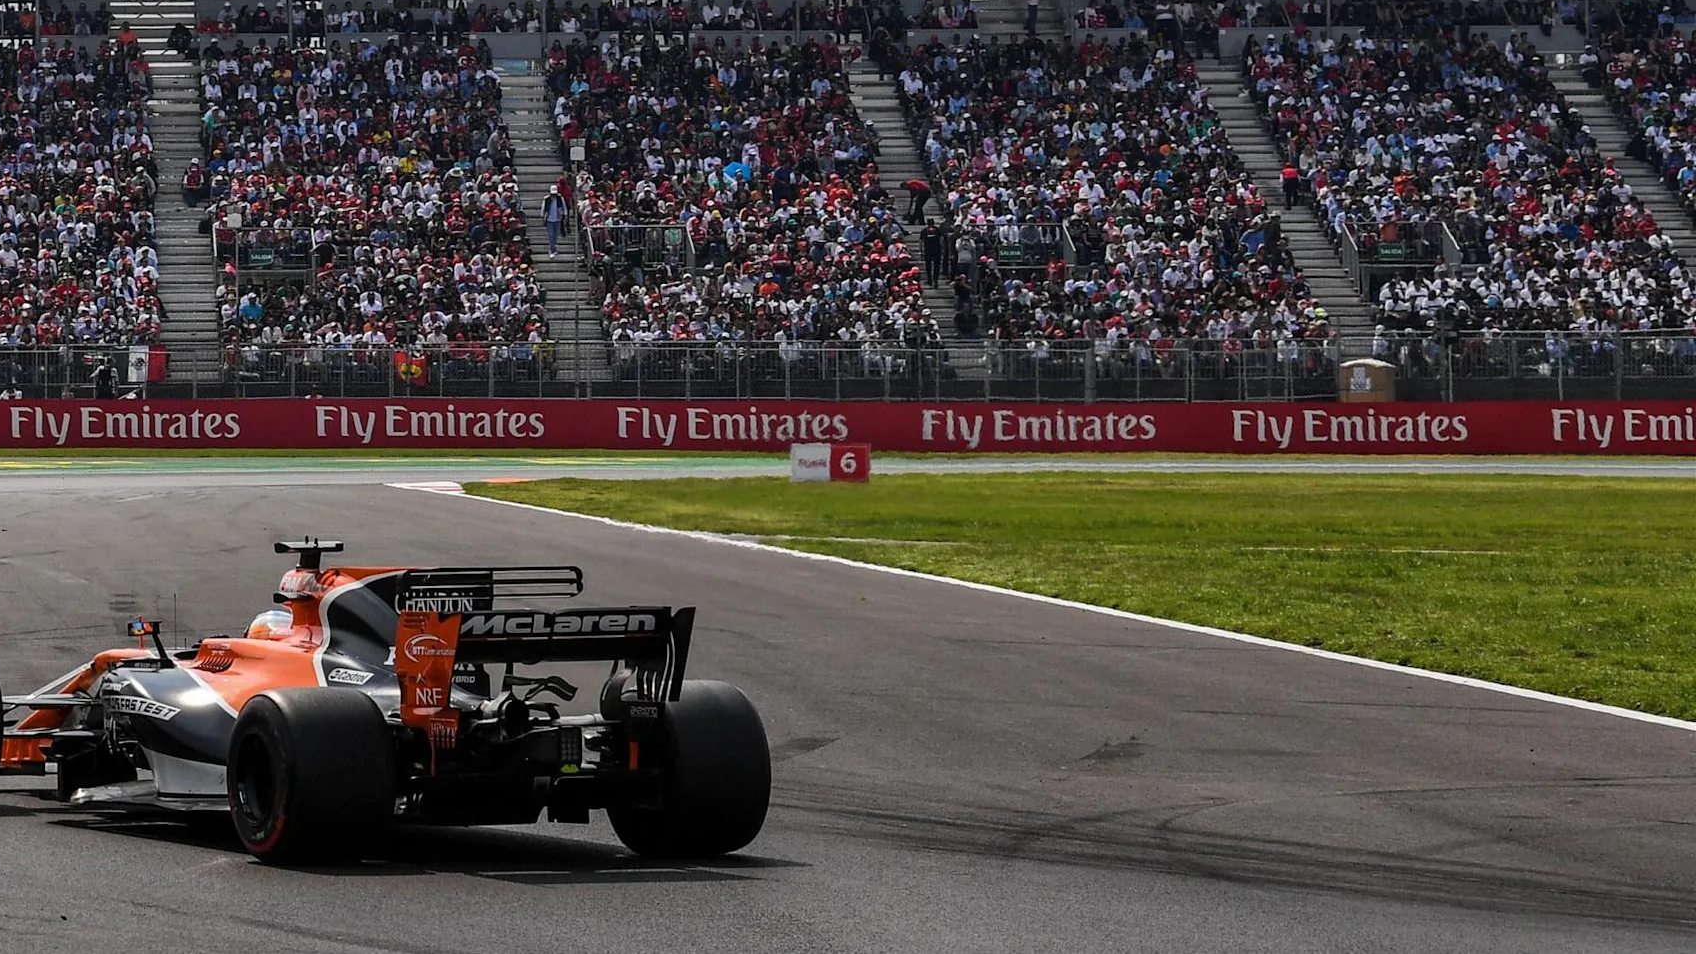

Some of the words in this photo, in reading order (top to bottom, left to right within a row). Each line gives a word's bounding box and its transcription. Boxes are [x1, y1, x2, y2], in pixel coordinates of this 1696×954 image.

[9, 406, 71, 446] Fly
[79, 406, 241, 439] Emirates
[314, 405, 376, 444] Fly
[384, 405, 545, 438] Emirates
[616, 406, 678, 447] Fly
[686, 406, 849, 442] Emirates
[922, 409, 984, 449] Fly
[992, 408, 1157, 442] Emirates
[1231, 409, 1293, 449] Fly
[1302, 408, 1468, 442] Emirates
[1551, 408, 1614, 449] Fly
[840, 452, 857, 474] 6
[459, 613, 656, 635] McLaren
[337, 670, 370, 683] Castrol
[415, 687, 443, 706] NRF
